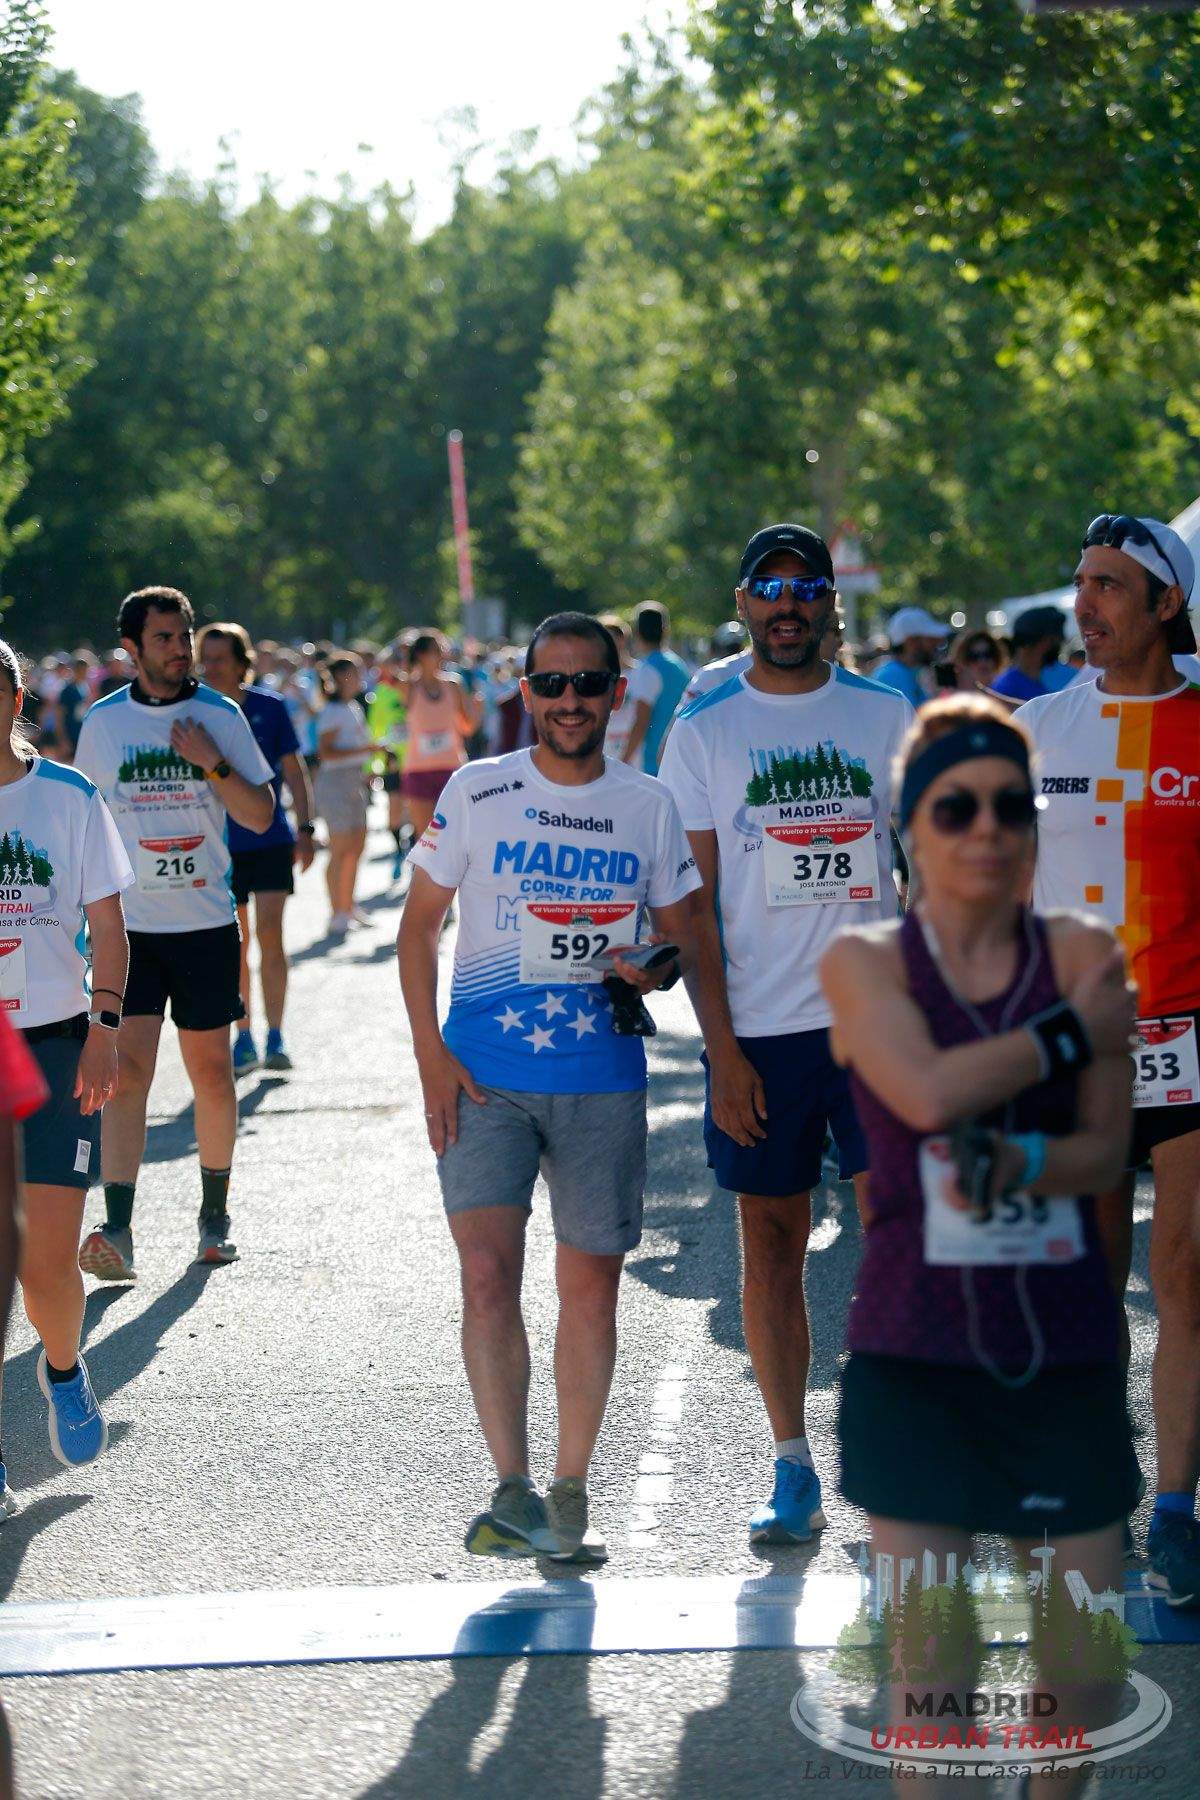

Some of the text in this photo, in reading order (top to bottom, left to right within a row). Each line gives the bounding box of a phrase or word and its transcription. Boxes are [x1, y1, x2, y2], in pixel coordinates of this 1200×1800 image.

[140, 784, 185, 792] MADRID
[1042, 777, 1090, 794] 226ERS
[779, 802, 843, 819] MADRID
[538, 810, 613, 834] Sabadell
[156, 857, 195, 876] 216
[493, 840, 640, 886] MADRID
[793, 852, 852, 880] 378
[520, 879, 614, 901] CORRE POR
[816, 880, 846, 888] ANTONIO
[15, 917, 26, 926] de
[551, 934, 609, 960] 592
